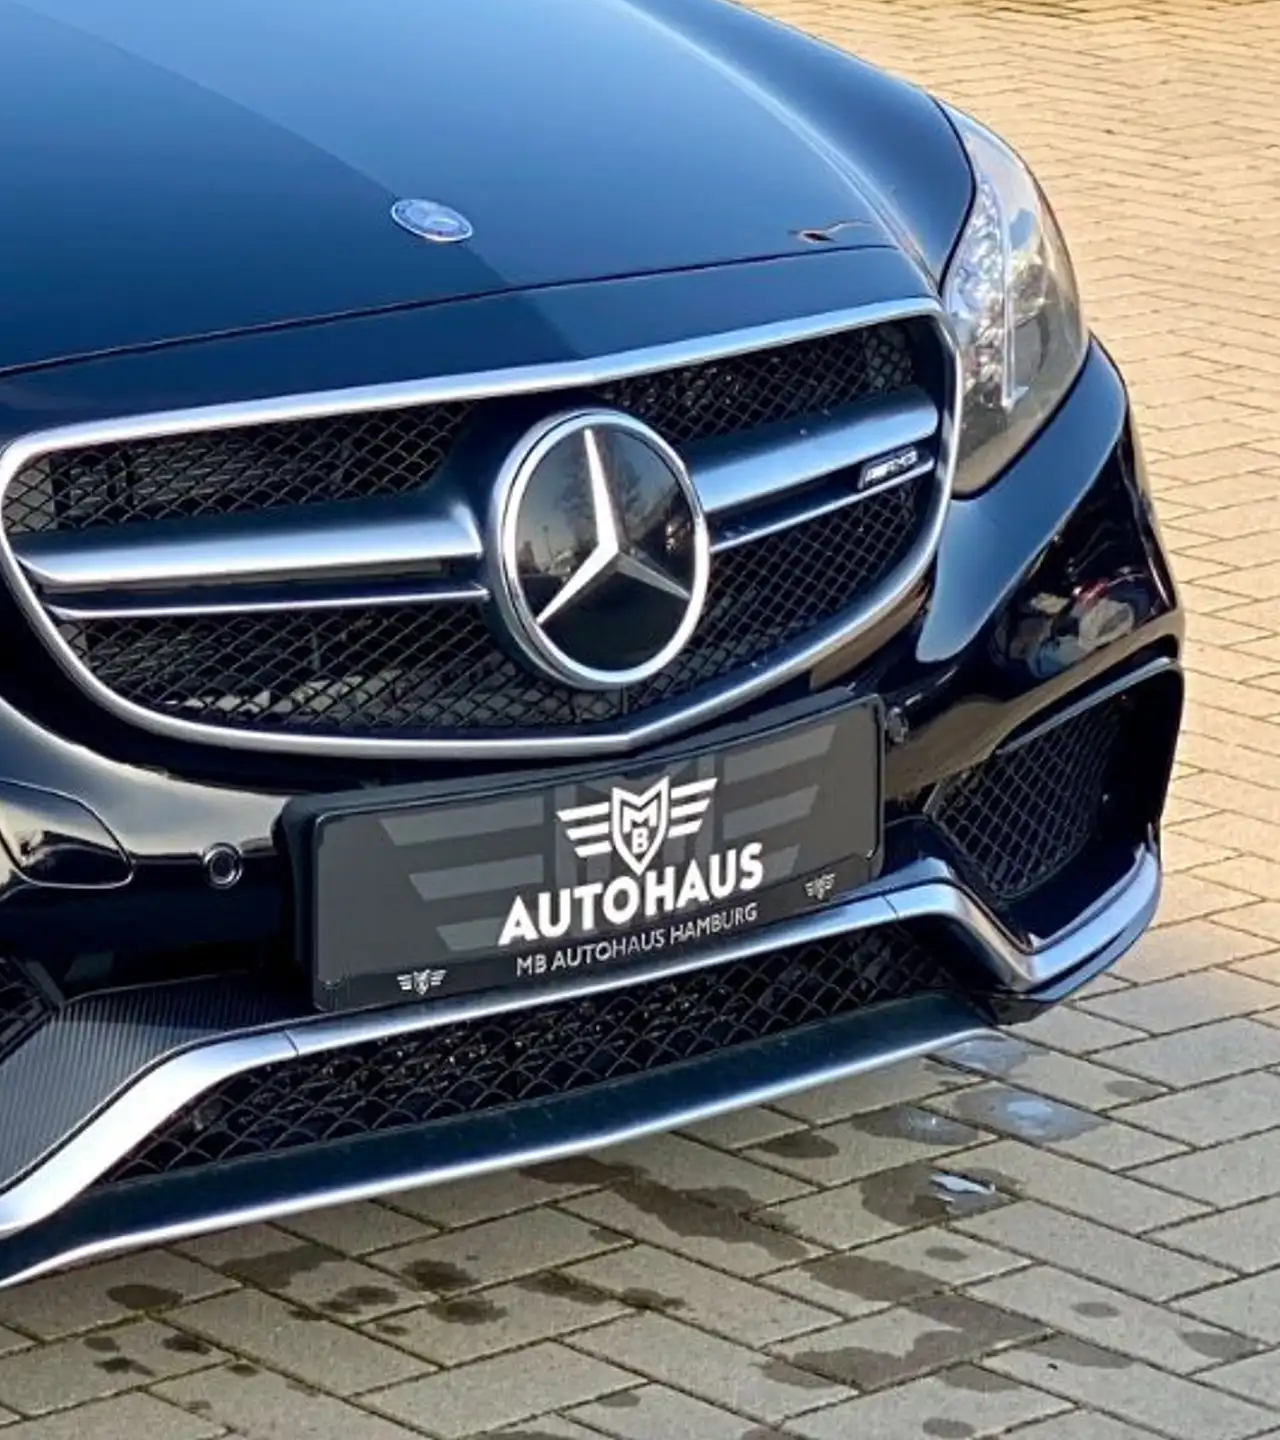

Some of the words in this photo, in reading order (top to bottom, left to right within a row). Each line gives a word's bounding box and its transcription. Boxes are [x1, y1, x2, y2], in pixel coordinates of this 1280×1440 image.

[497, 841, 764, 947] AUTOHAUS
[516, 954, 548, 978] MB
[550, 928, 666, 972] AUTOHAUS
[669, 902, 759, 945] HAMBURG
